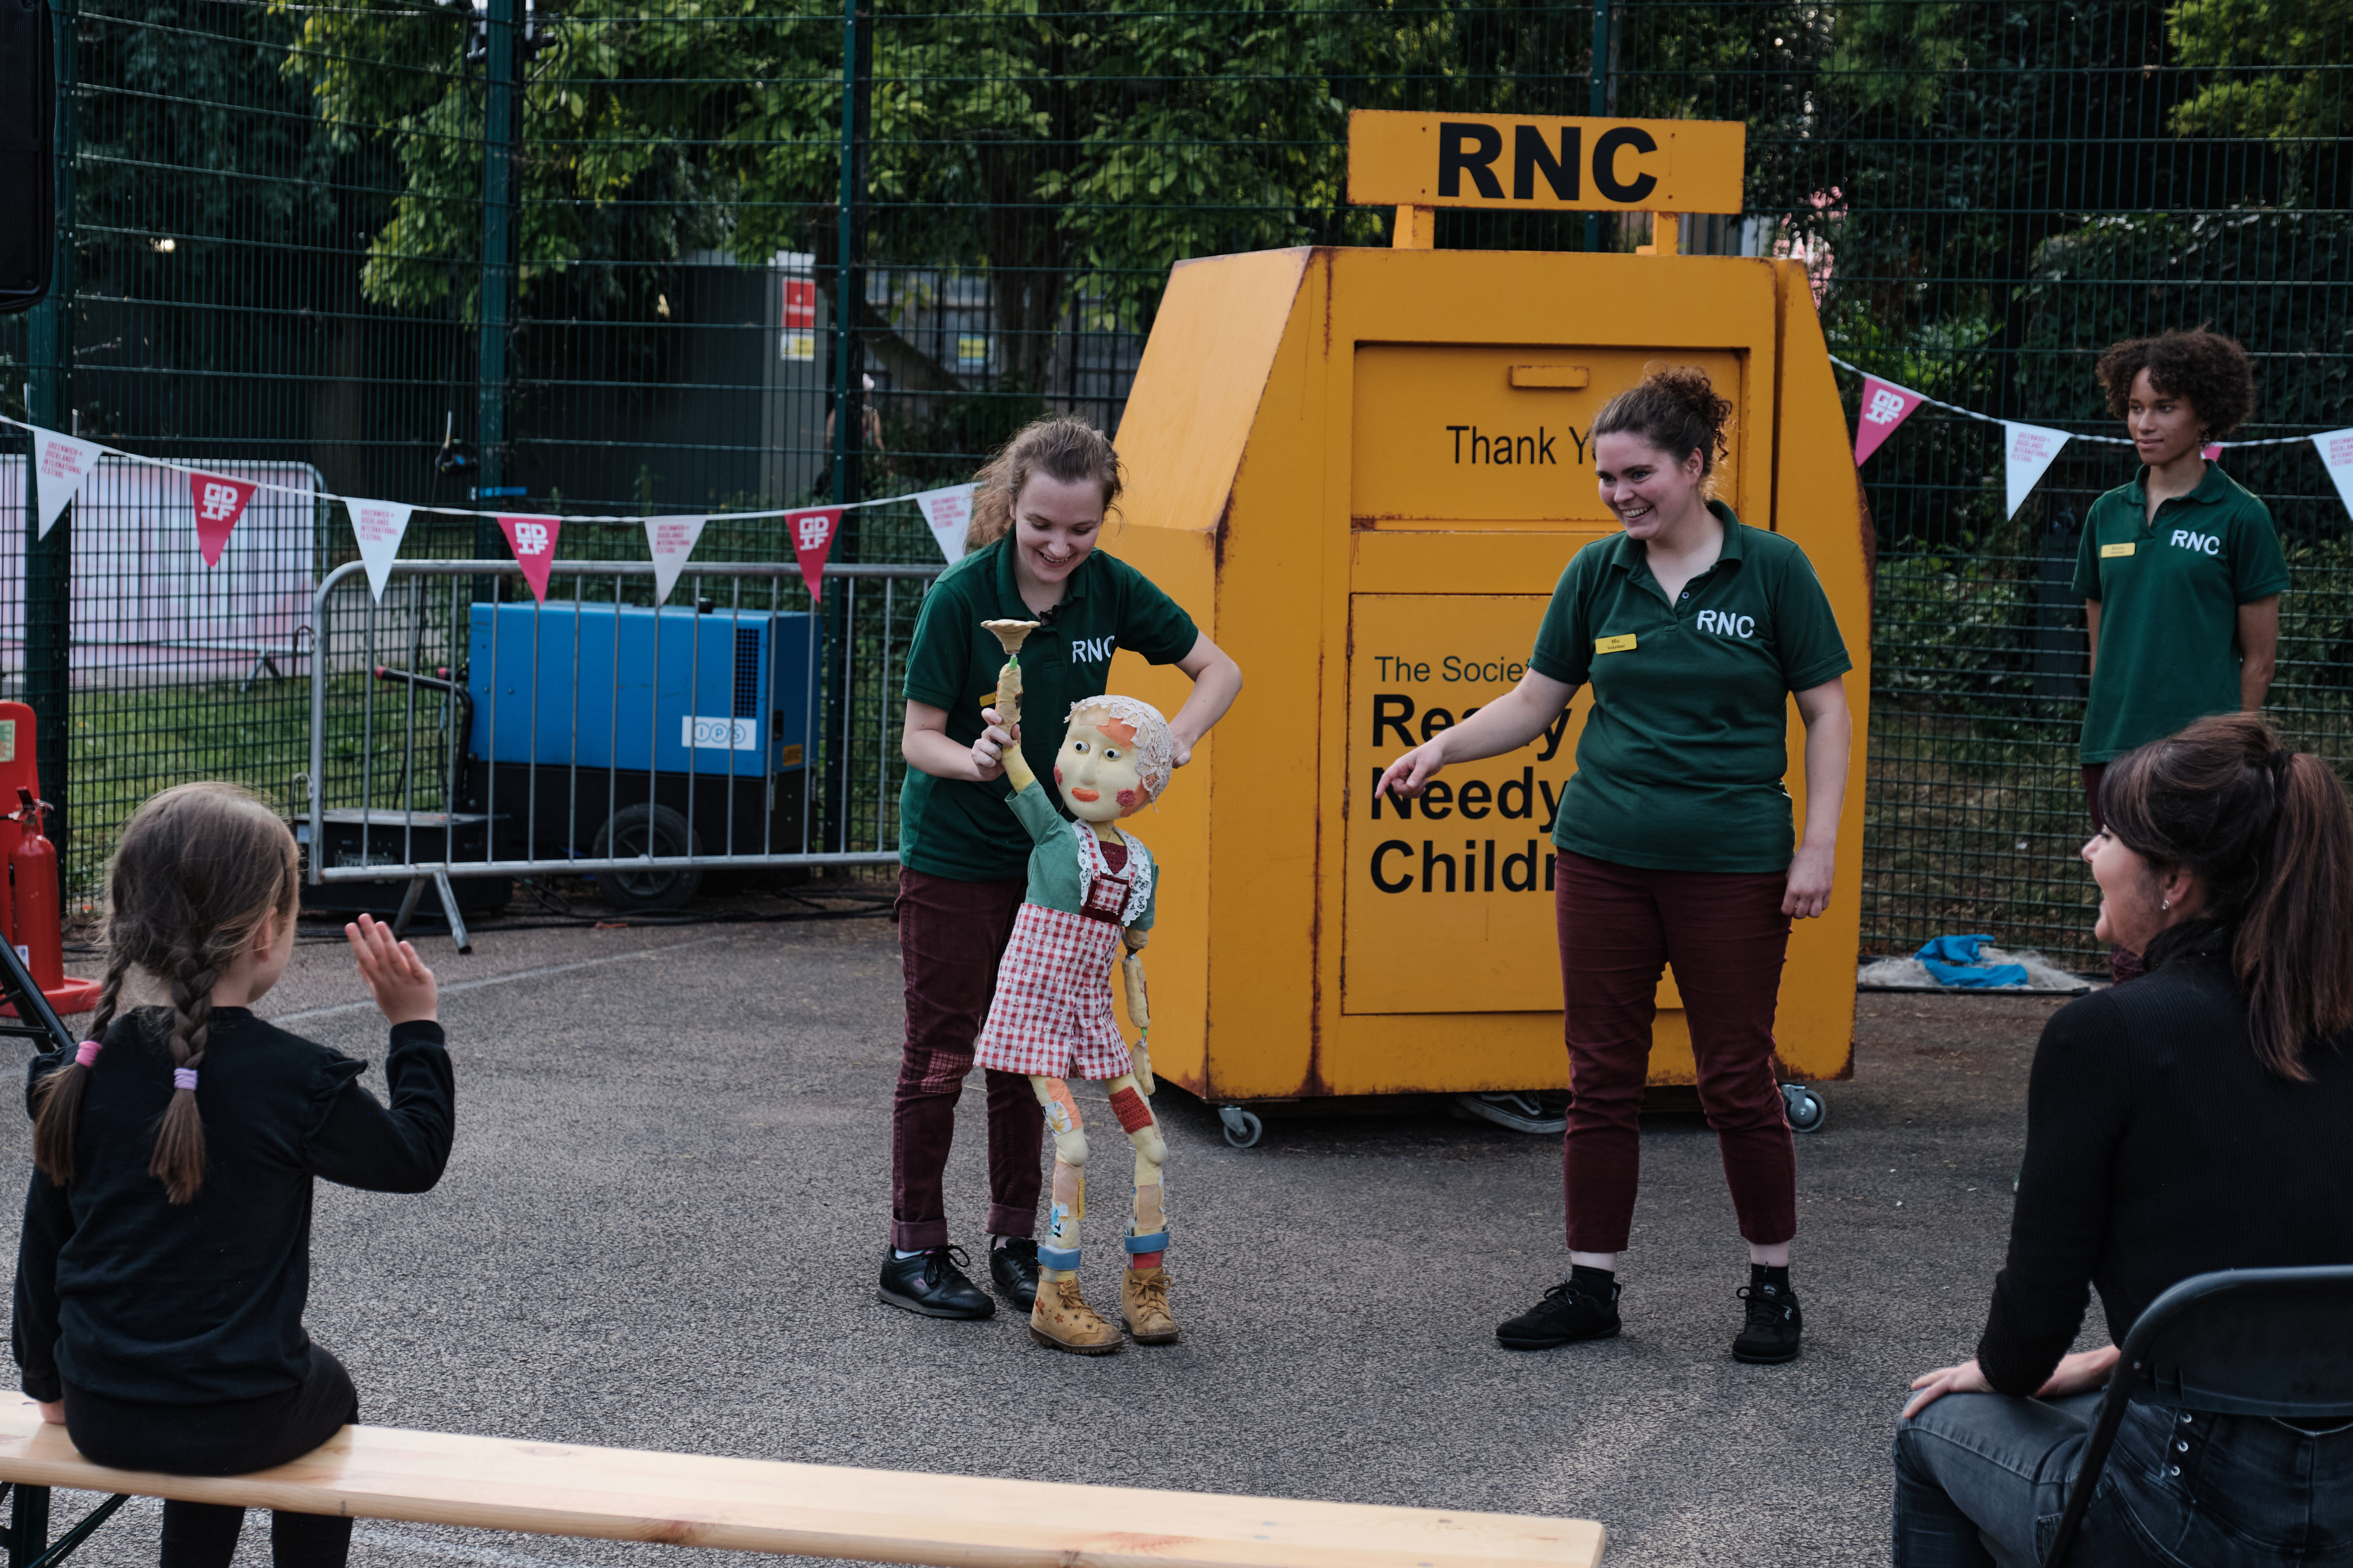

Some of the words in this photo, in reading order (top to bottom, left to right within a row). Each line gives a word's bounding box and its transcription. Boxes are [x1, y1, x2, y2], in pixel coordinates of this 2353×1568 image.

[1438, 122, 1658, 203] RNC
[1446, 425, 1557, 465] Thank
[1569, 426, 1597, 465] Y
[2171, 529, 2220, 555] RNC
[1697, 610, 1755, 638] RNC
[1072, 635, 1115, 663] RNC
[1374, 656, 1430, 682] The
[1371, 766, 1568, 833] Needy
